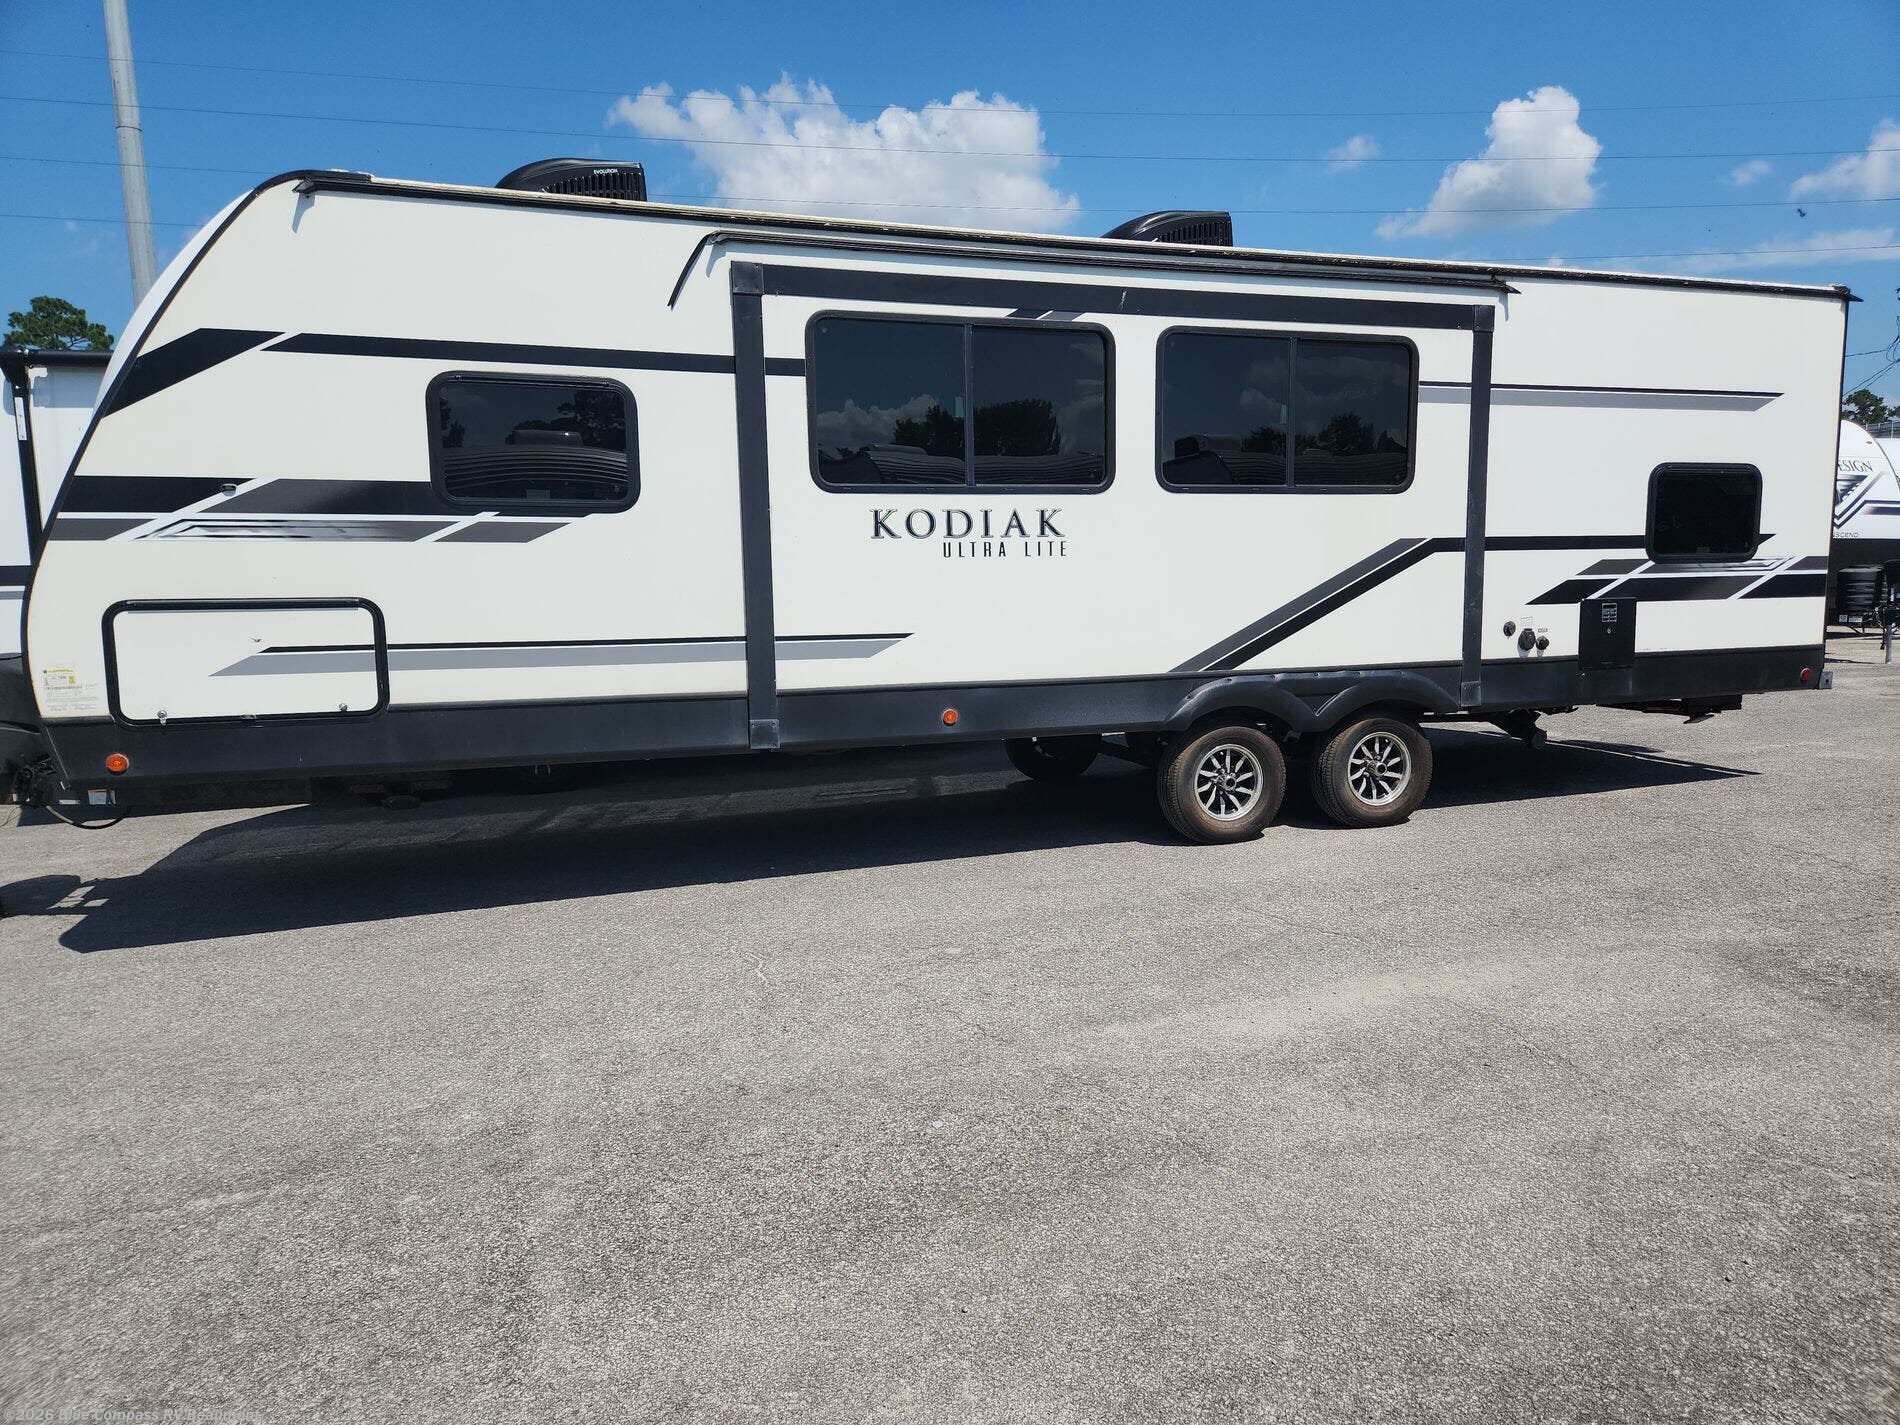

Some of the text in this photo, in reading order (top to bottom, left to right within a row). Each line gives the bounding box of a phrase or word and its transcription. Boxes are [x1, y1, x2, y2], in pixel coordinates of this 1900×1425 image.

[869, 507, 1066, 540] KODIAK
[943, 540, 1068, 558] ULTRA LITE
